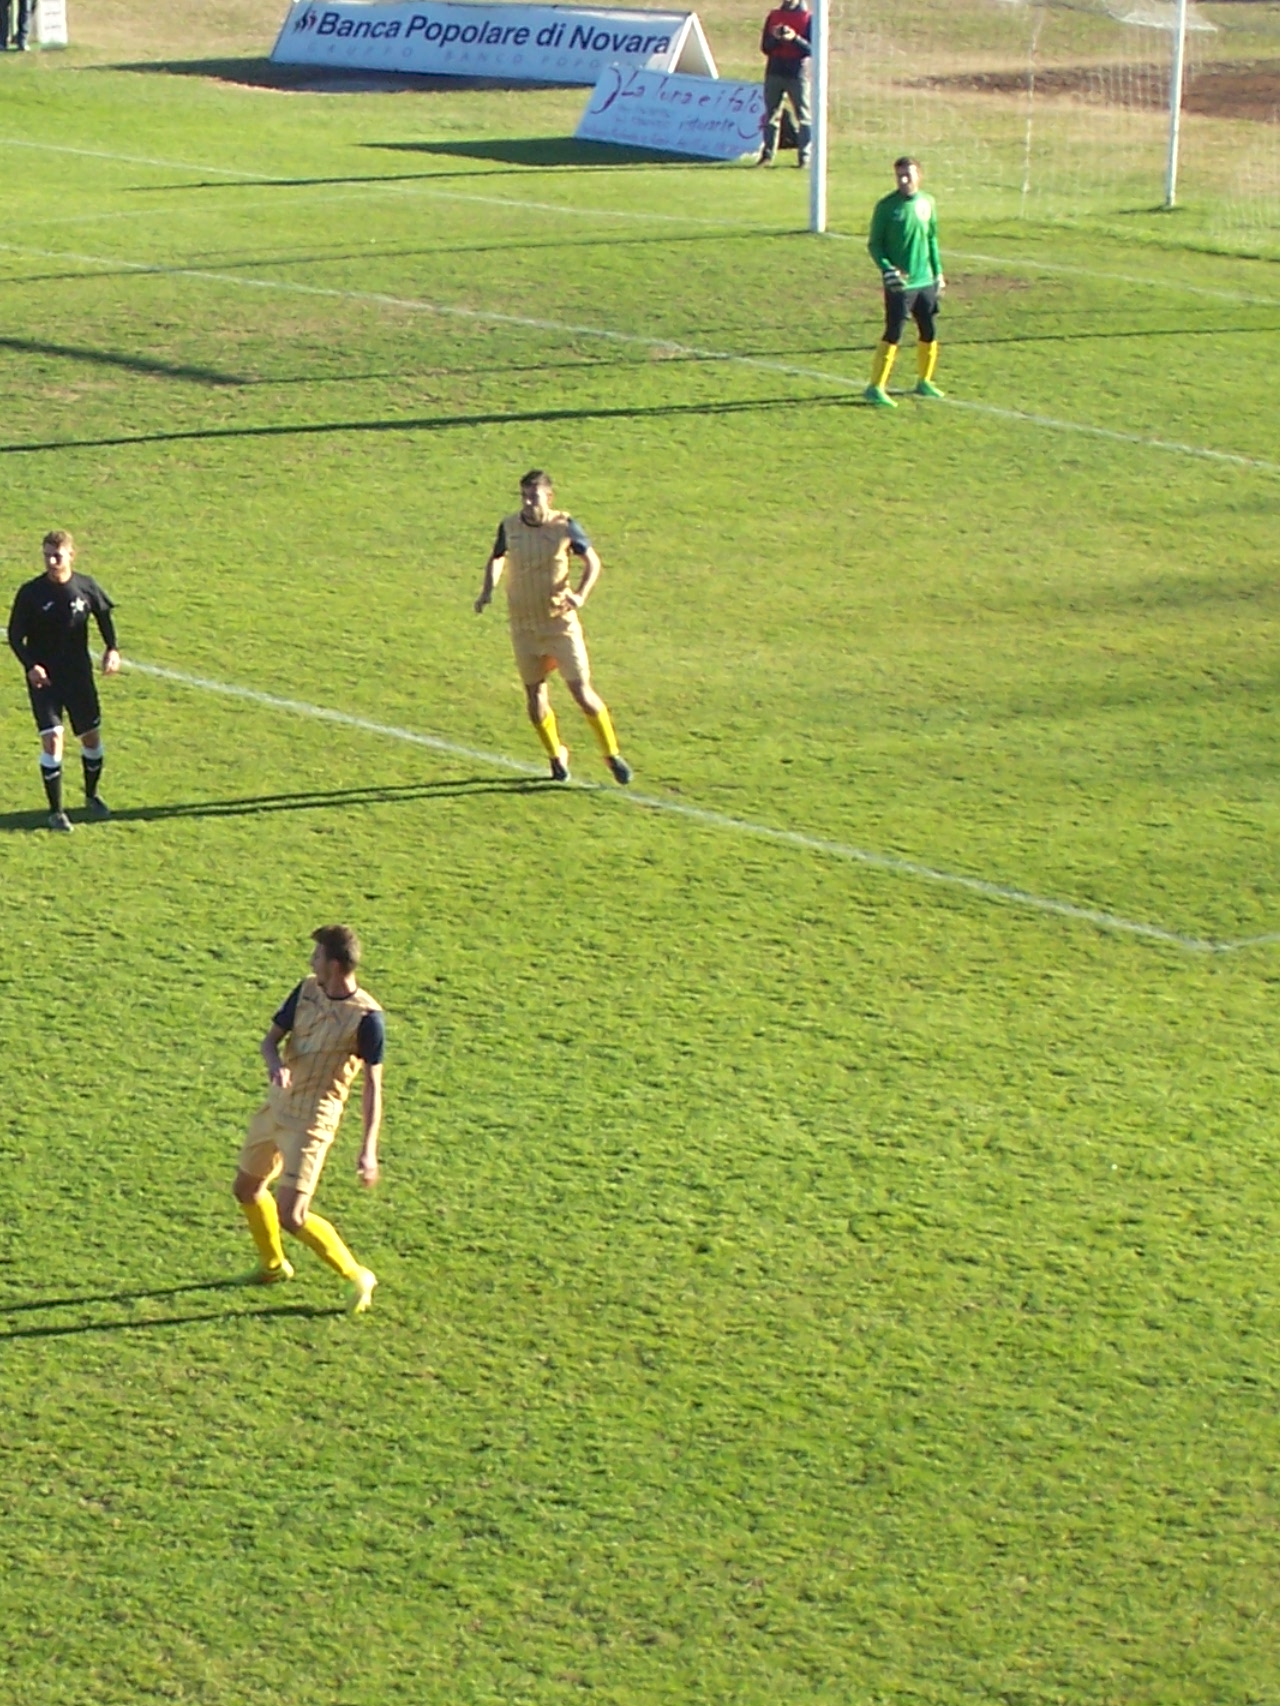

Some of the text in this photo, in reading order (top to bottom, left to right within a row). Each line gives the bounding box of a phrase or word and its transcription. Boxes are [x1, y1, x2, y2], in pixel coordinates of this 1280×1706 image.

[316, 11, 671, 54] Banca Popolare di Novara
[621, 70, 646, 97] La
